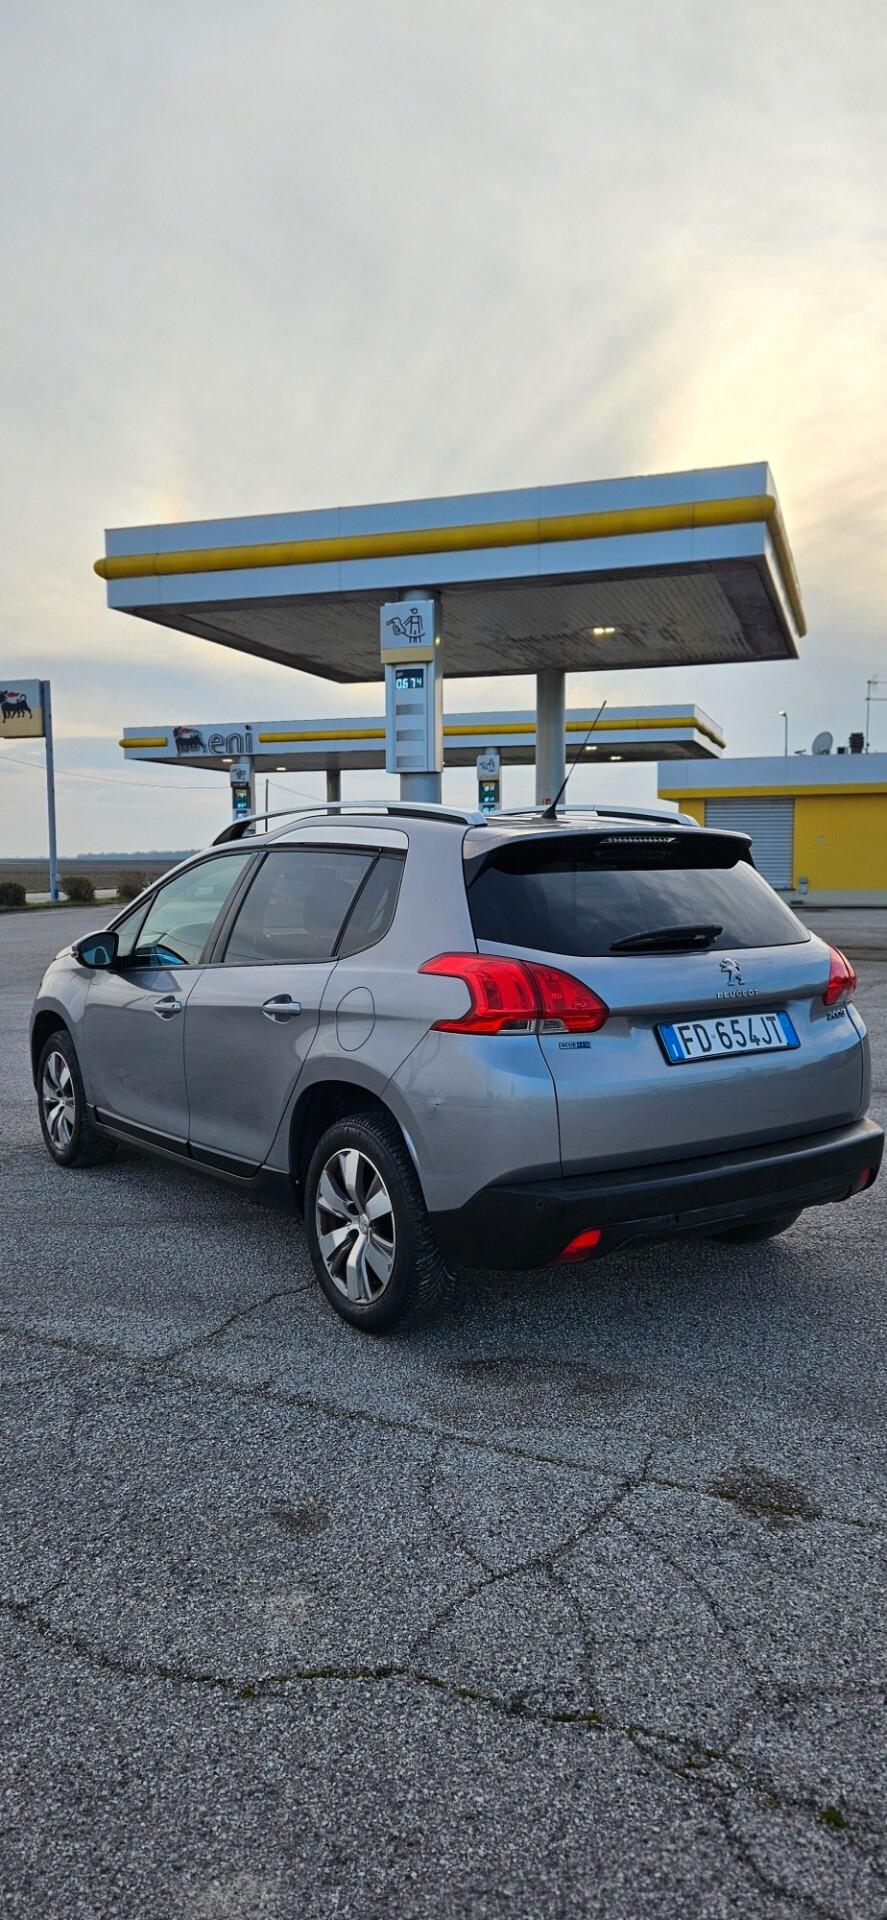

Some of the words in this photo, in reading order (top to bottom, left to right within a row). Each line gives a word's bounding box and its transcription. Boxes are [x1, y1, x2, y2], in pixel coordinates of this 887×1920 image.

[208, 725, 253, 754] eni
[717, 989, 759, 999] PEUGEOT
[678, 1023, 712, 1055] FD
[715, 1016, 782, 1049] 654JT
